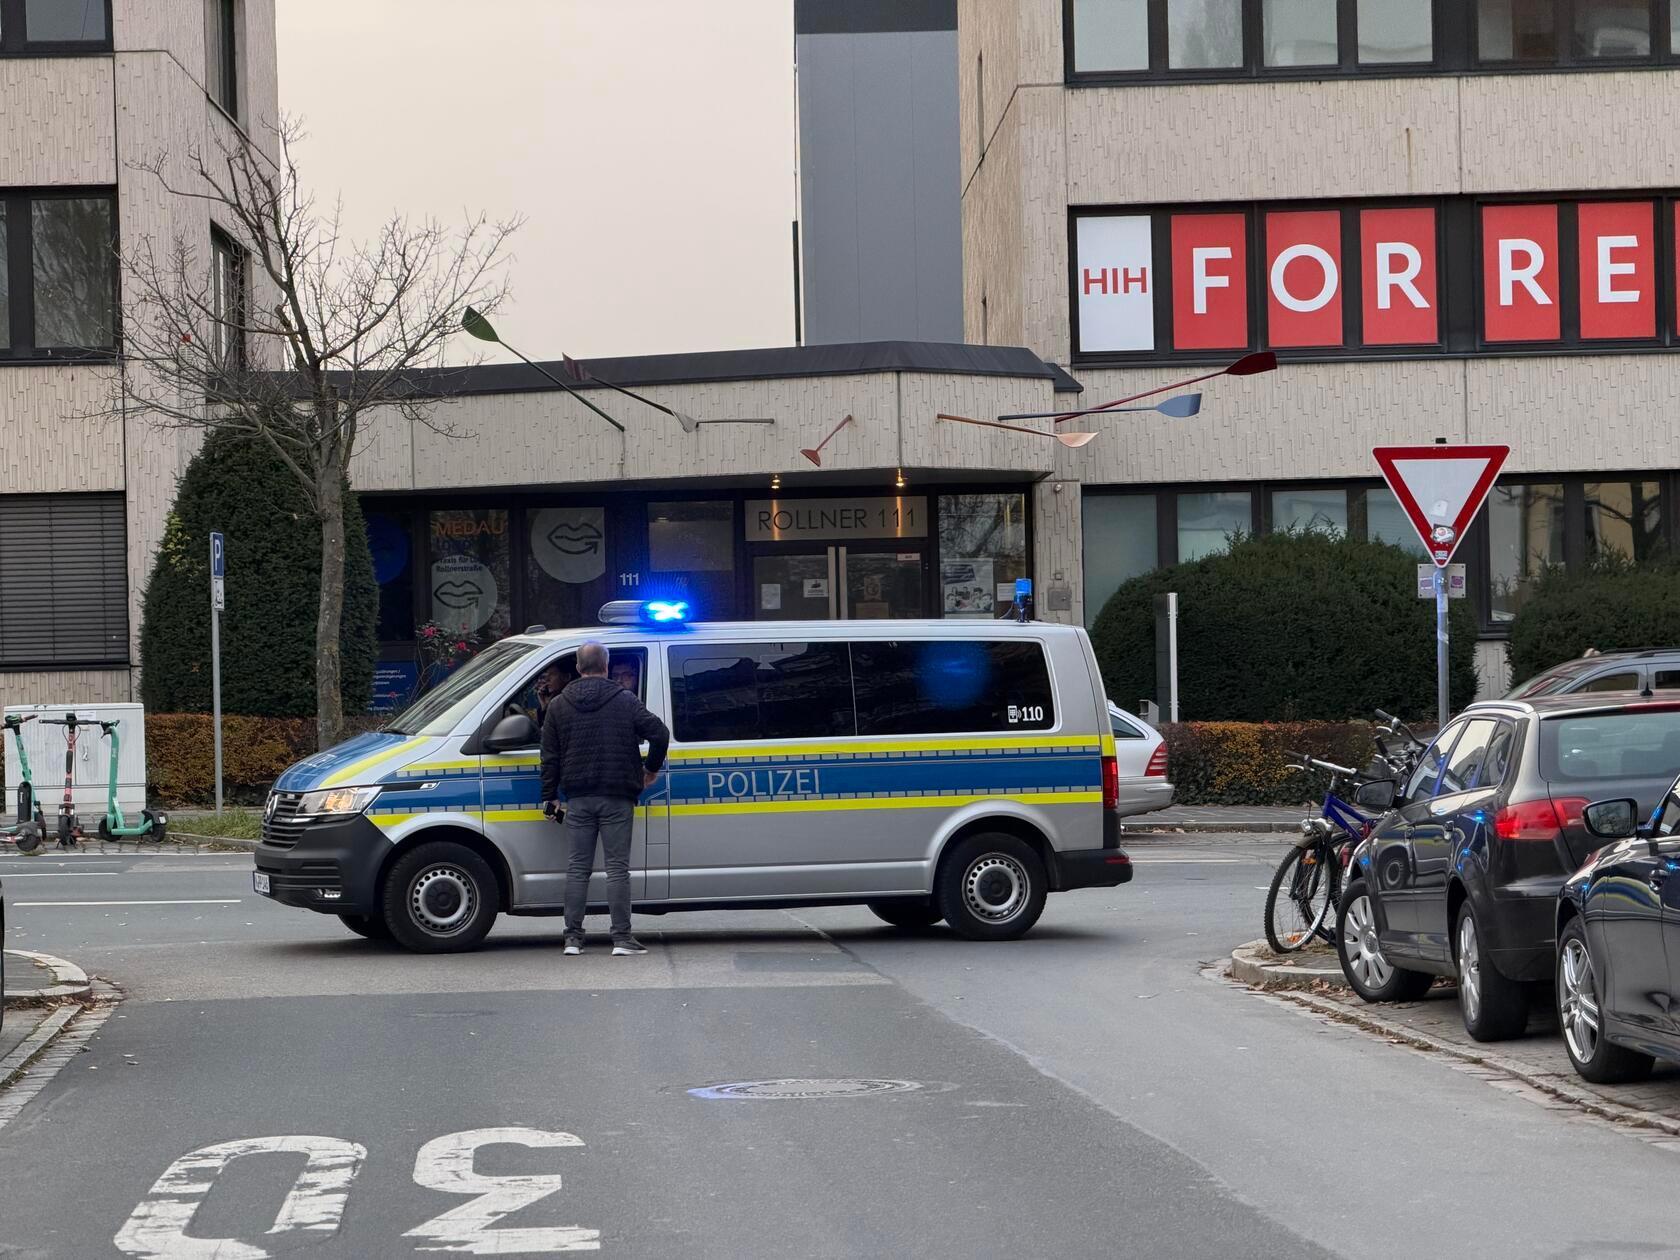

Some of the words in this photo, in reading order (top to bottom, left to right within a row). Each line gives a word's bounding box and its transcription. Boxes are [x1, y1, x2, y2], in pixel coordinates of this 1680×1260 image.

[1083, 266, 1148, 295] HIH
[1192, 242, 1431, 314] FOR
[436, 520, 505, 538] MEDAU
[758, 508, 868, 531] ROLLNER
[878, 507, 914, 528] 111
[214, 539, 221, 571] P
[619, 572, 640, 586] 111
[1021, 706, 1044, 721] 110
[707, 769, 820, 798] POLIZEI
